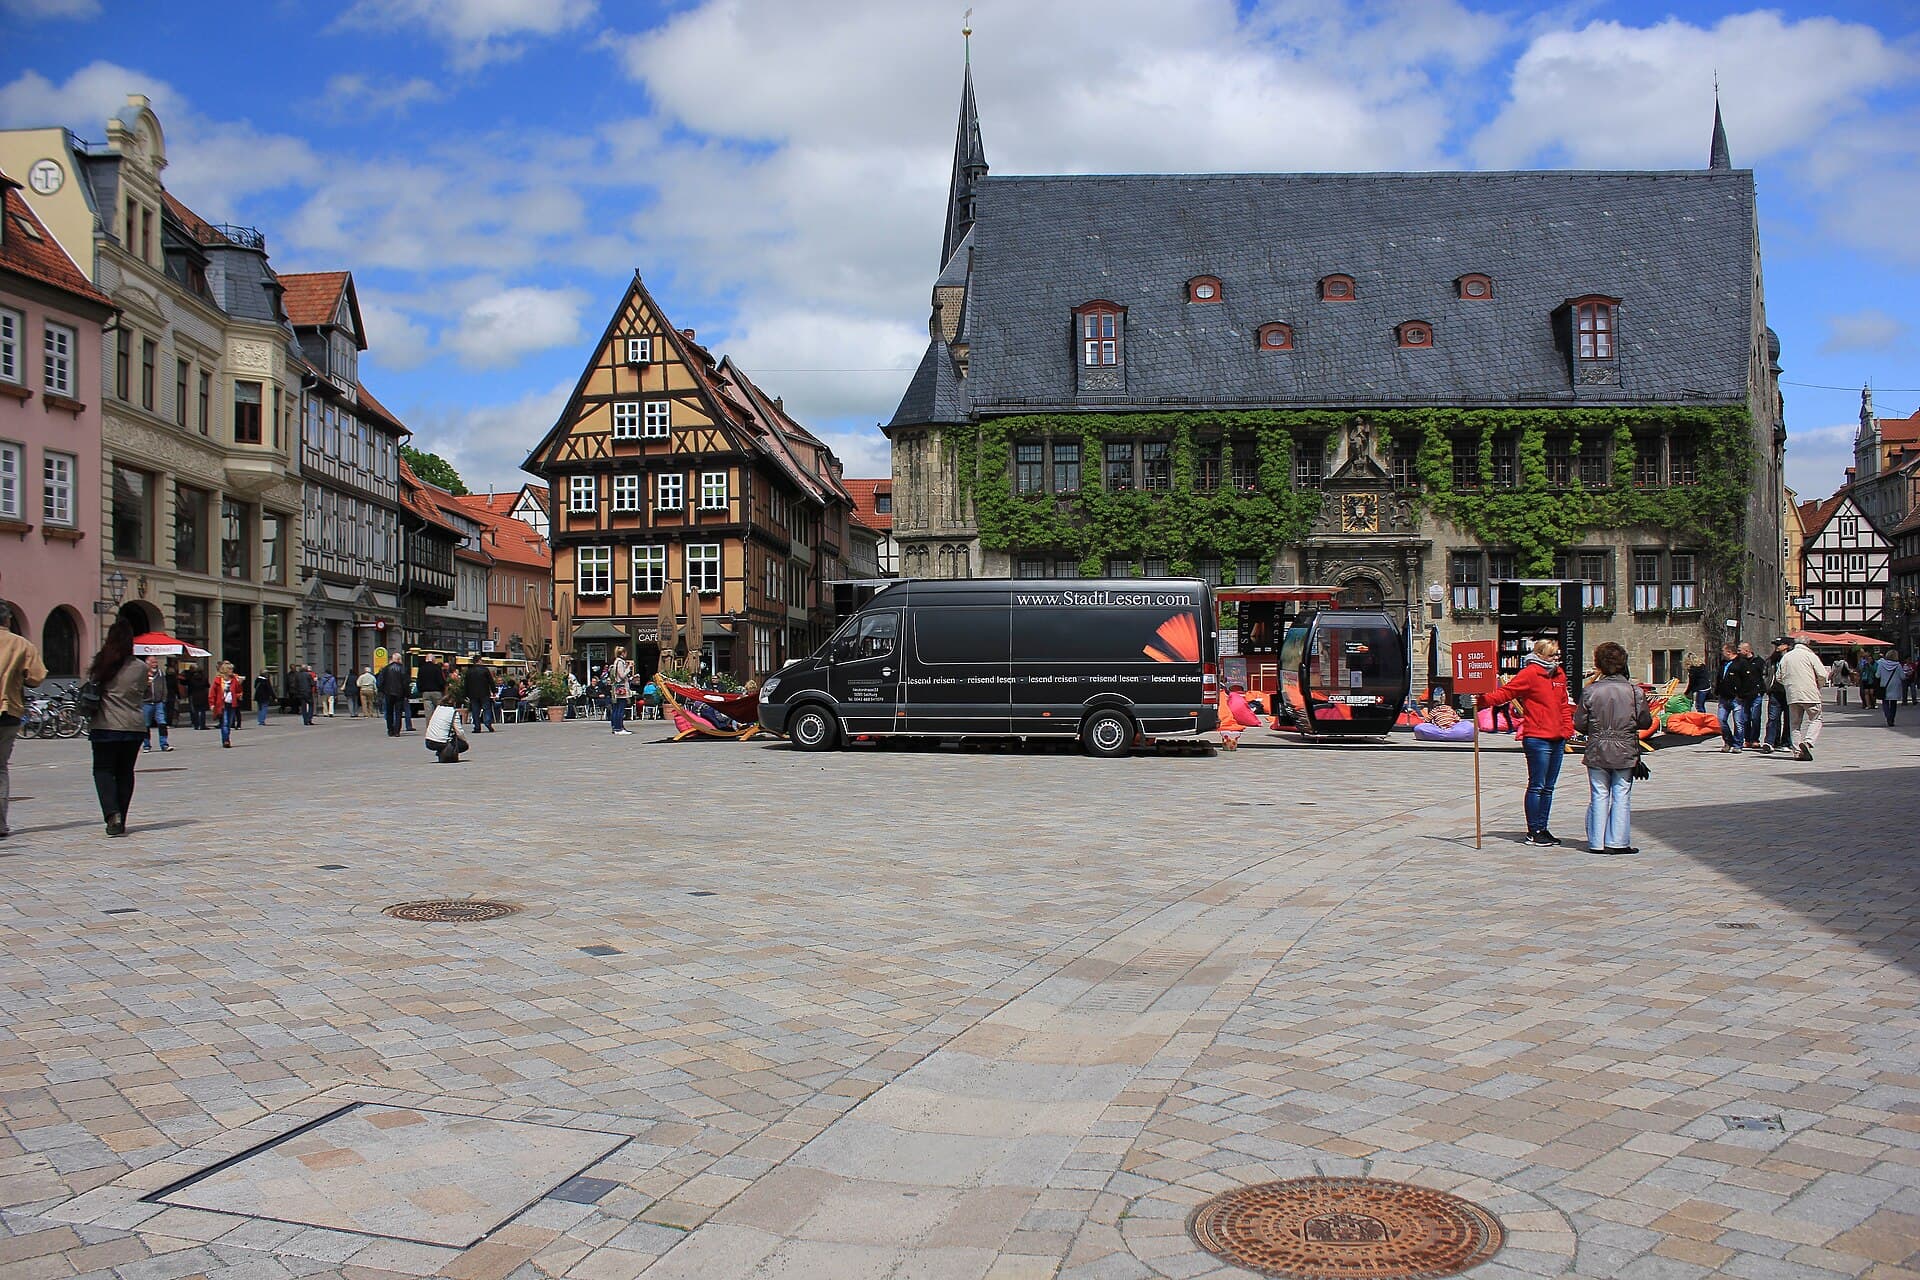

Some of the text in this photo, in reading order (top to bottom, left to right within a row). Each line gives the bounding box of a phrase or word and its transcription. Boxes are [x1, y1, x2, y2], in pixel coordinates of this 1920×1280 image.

[1016, 590, 1191, 606] www.StadtLesen.com
[1468, 661, 1493, 669] FÜHRUNG
[907, 676, 931, 685] lesend
[933, 676, 956, 685] reisen
[967, 675, 995, 684] reisend
[996, 675, 1016, 684] lesen
[1028, 675, 1052, 683] lesend
[1054, 674, 1078, 683] reisen
[1089, 674, 1117, 683] reisend
[1119, 674, 1139, 683] lesen
[1151, 674, 1176, 683] lesend
[1177, 674, 1201, 683] reisen
